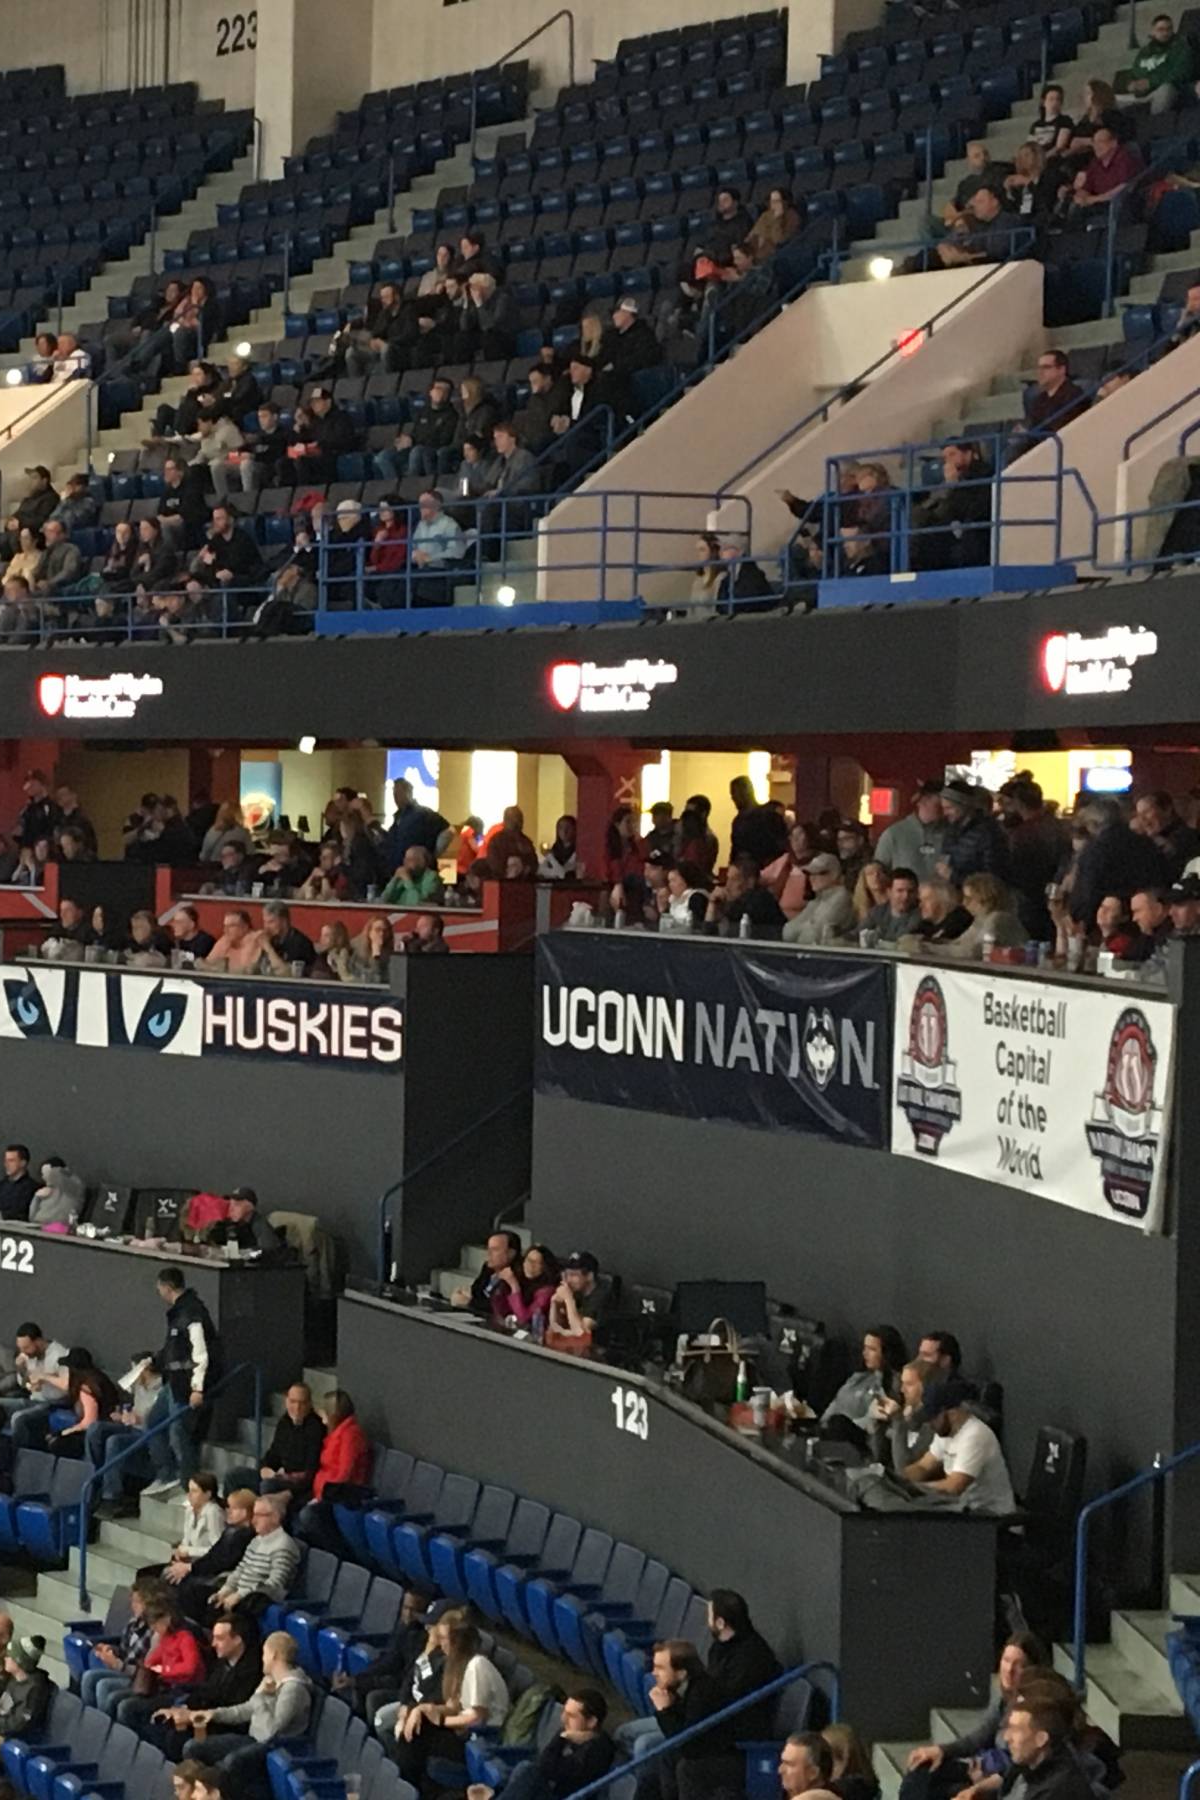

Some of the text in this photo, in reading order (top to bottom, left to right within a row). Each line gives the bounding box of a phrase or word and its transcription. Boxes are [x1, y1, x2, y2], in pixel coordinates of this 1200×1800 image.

[216, 10, 258, 57] 223
[204, 994, 403, 1063] HUSKIES
[542, 984, 877, 1091] UCONN NATIN
[983, 990, 1068, 1040] Basketball
[995, 1040, 1052, 1087] Capital
[996, 1090, 1016, 1126] of
[1017, 1093, 1048, 1134] the
[997, 1134, 1045, 1181] World
[611, 1385, 649, 1441] 123
